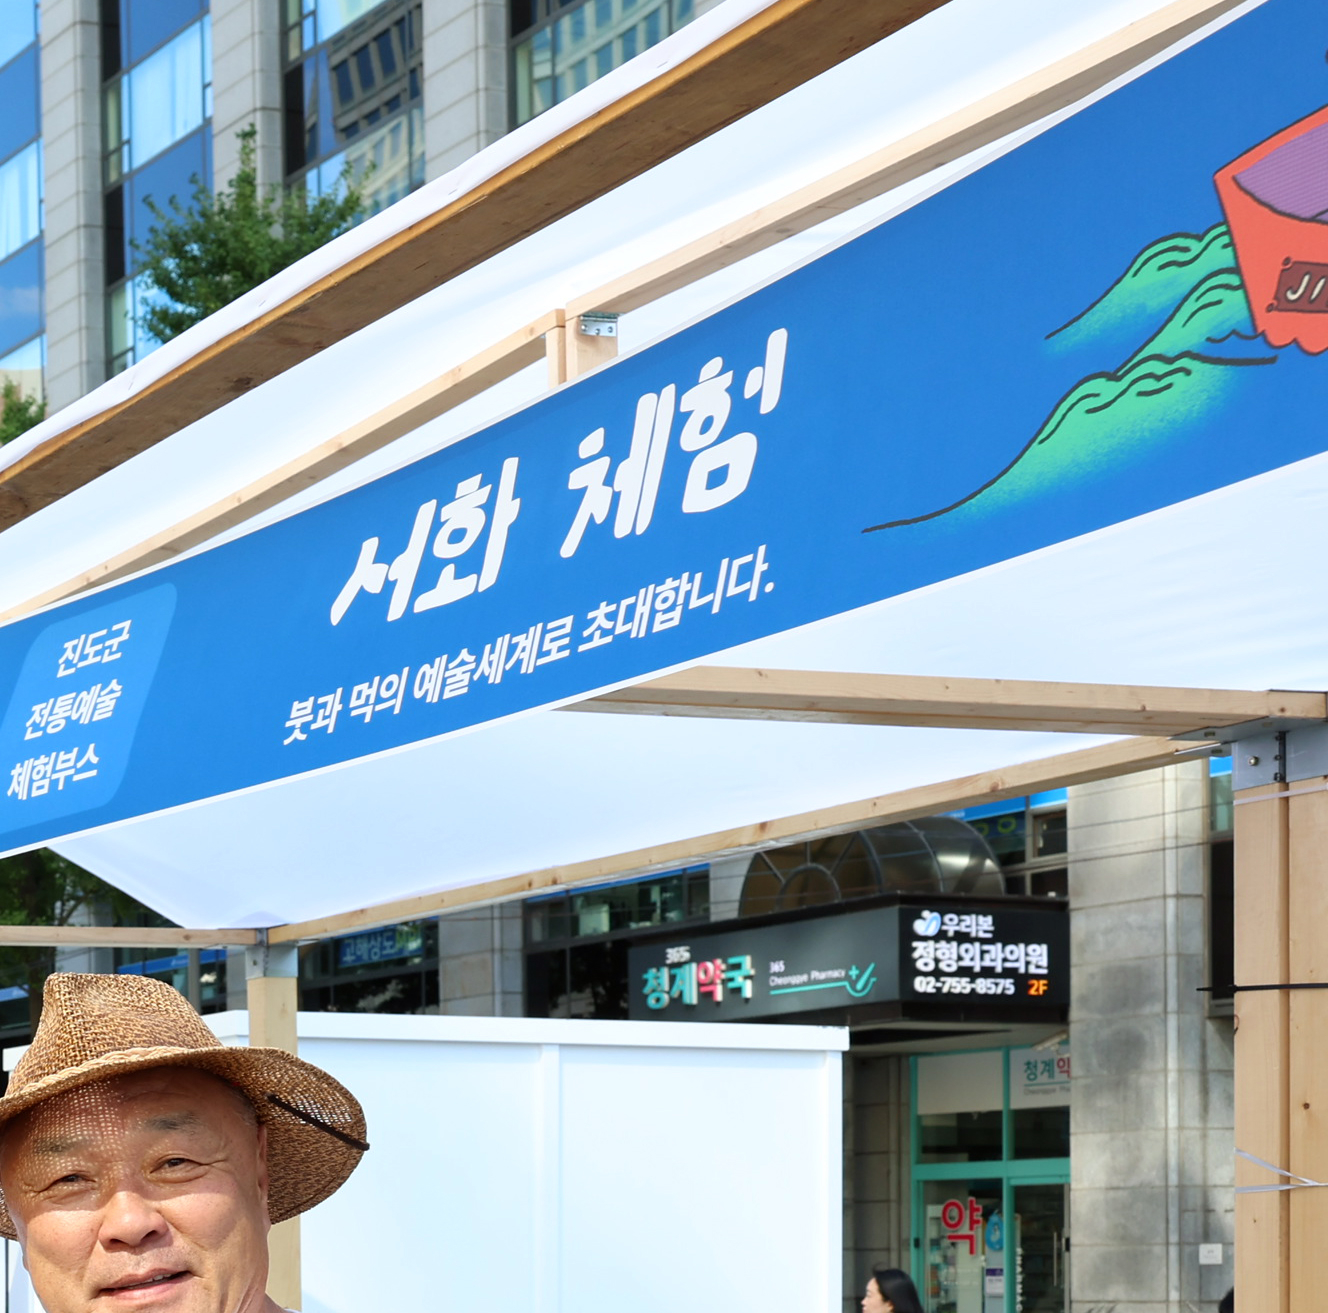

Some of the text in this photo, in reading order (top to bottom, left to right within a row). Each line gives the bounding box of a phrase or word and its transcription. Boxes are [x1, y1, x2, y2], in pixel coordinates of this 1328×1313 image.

[330, 327, 789, 626] 서화 체험
[56, 619, 132, 678] 진도군
[283, 543, 775, 746] 붓과 먹의 예술세계로 초대합니다.
[23, 678, 122, 741] 전통예술
[6, 742, 99, 801] 체험부스
[941, 912, 995, 938] 우리본
[642, 955, 756, 1010] 청계약국
[665, 946, 691, 965] 365
[769, 960, 785, 973] 365
[810, 969, 846, 981] Pharmacy
[911, 940, 1049, 974] 정형외과의원
[913, 975, 1050, 996] 02-755-8575 2F
[942, 1196, 984, 1256] 약
